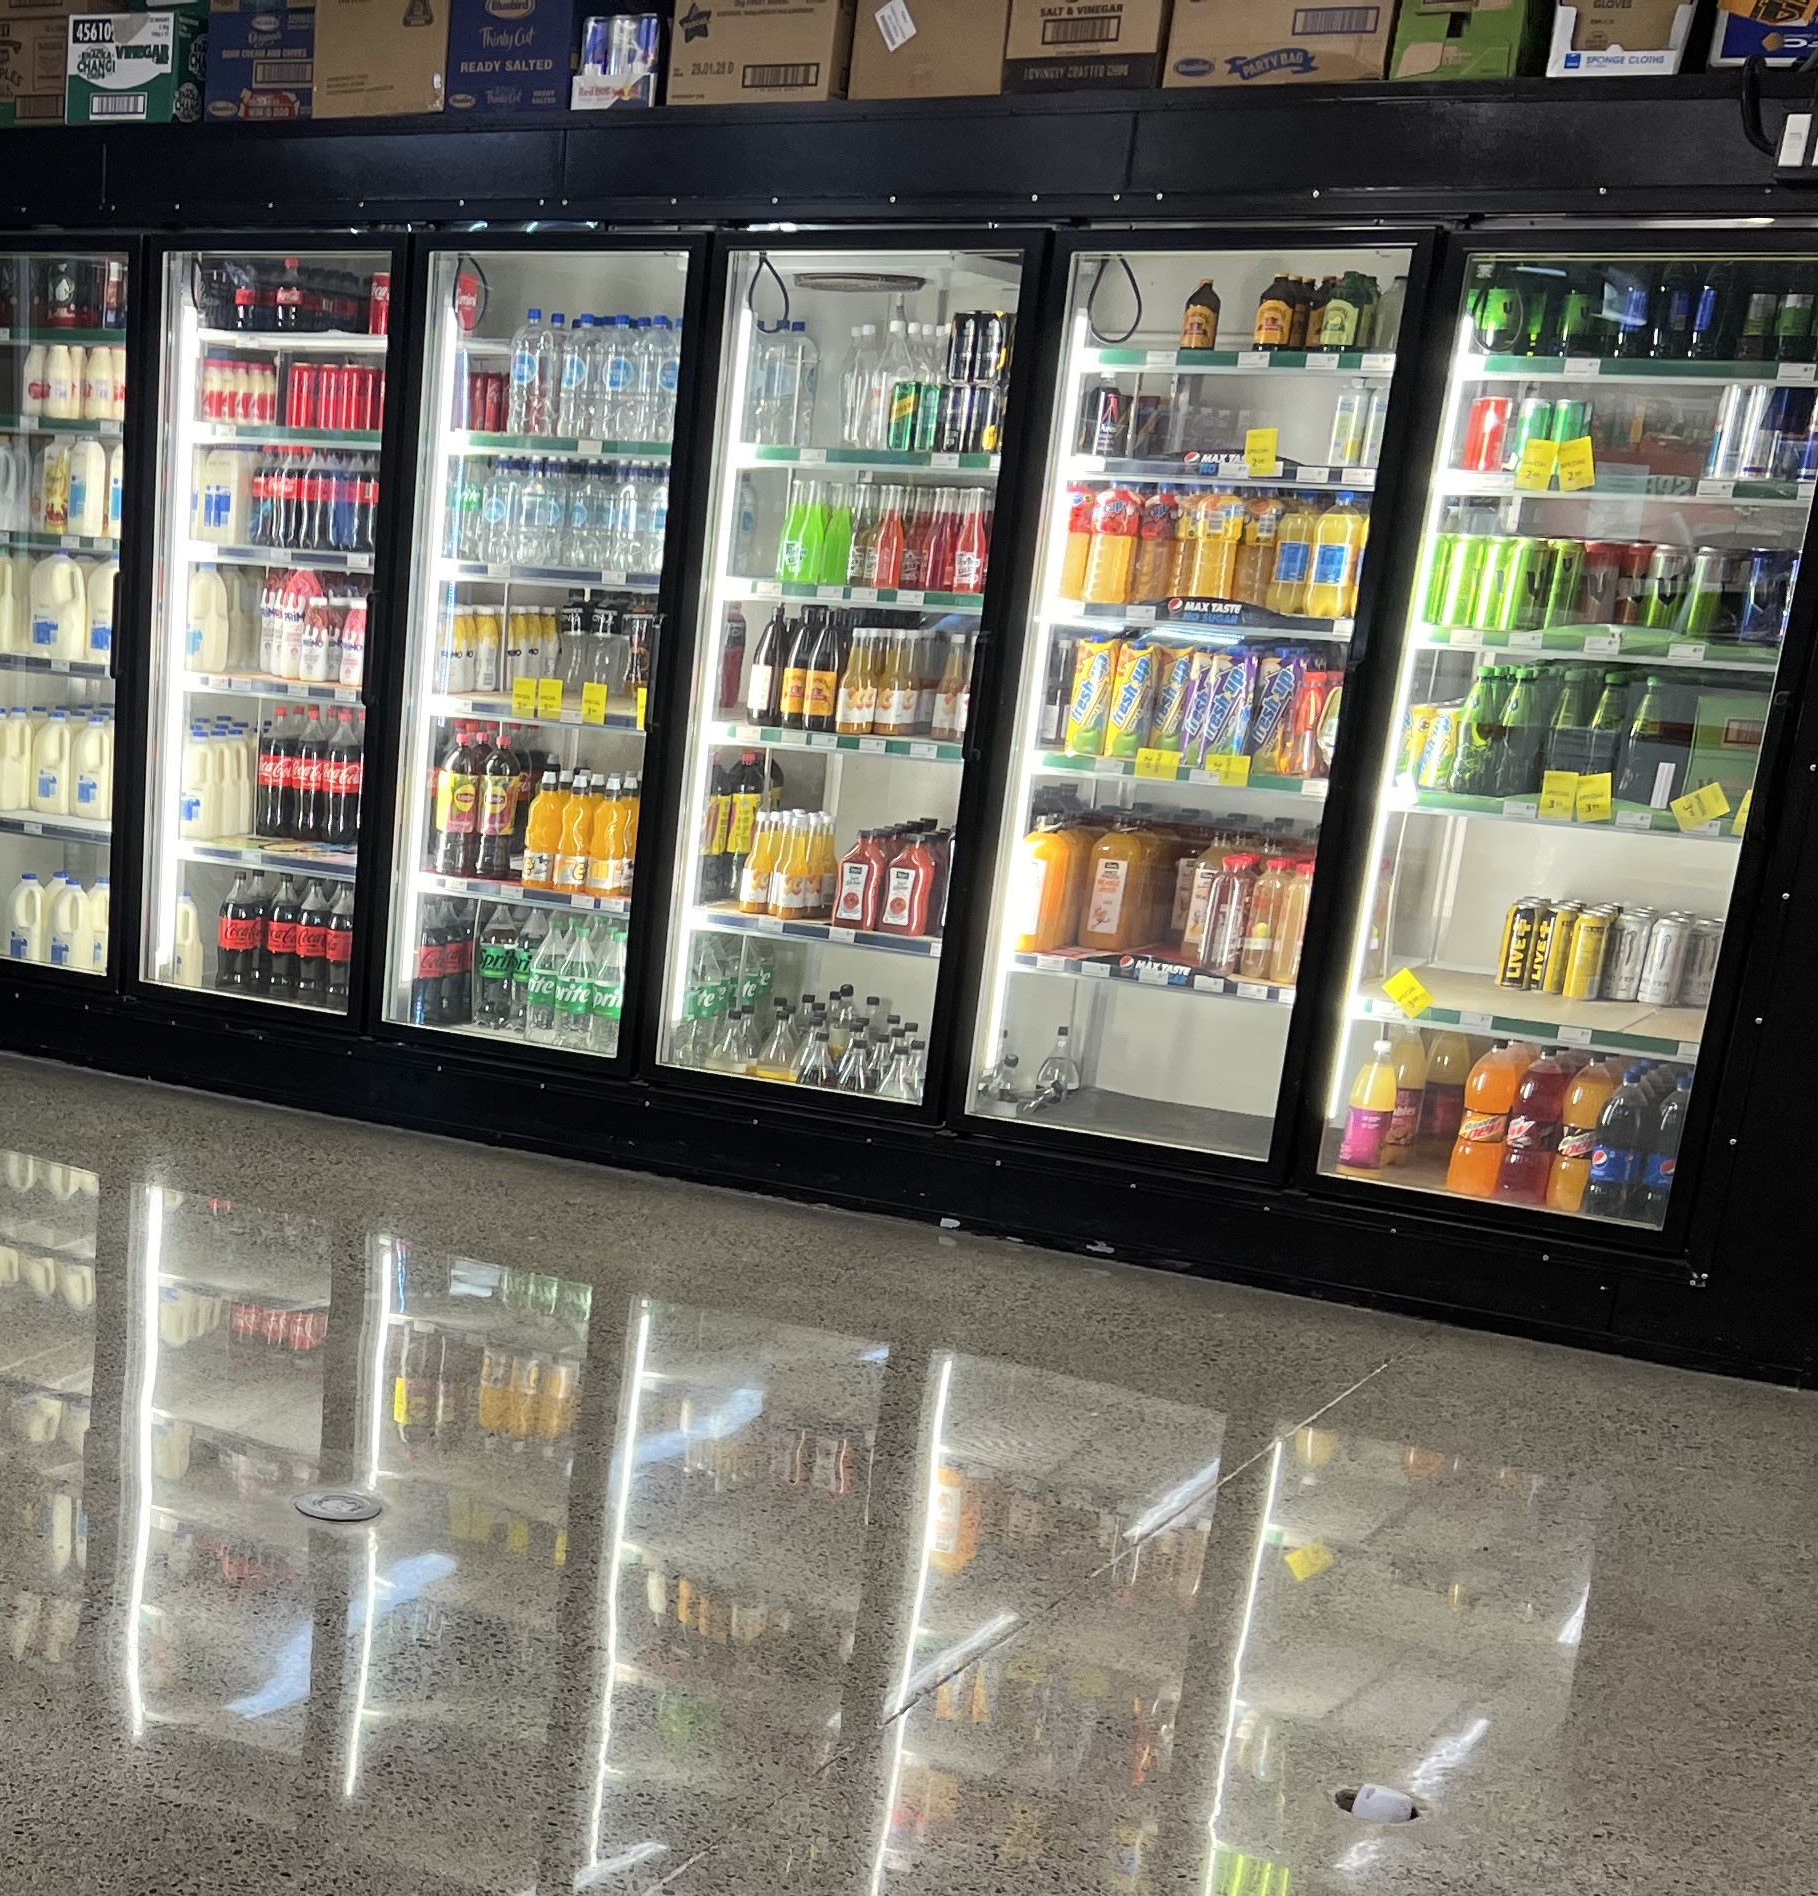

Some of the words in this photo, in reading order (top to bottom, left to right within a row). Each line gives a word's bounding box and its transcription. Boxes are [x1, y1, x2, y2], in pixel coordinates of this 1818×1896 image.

[1040, 8, 1063, 17] SALT
[1077, 4, 1123, 15] VINEGAR
[76, 22, 112, 42] 45610
[479, 26, 514, 52] Thinly
[514, 27, 536, 46] Cut
[460, 61, 502, 73] READY
[505, 59, 553, 71] SALTED
[1243, 55, 1278, 78] PARTY
[1280, 51, 1304, 68] BAG
[1586, 56, 1625, 64] SPONGE
[1628, 56, 1665, 64] CLOTHS
[1201, 454, 1227, 463] MAX
[1199, 464, 1216, 474] NO
[1184, 601, 1210, 612] MAX
[1211, 602, 1242, 613] TASTE
[1184, 613, 1201, 623] NO
[1203, 613, 1238, 625] SUGAR
[1131, 655, 1152, 685] up
[1226, 666, 1248, 696] up
[1271, 668, 1295, 701] up
